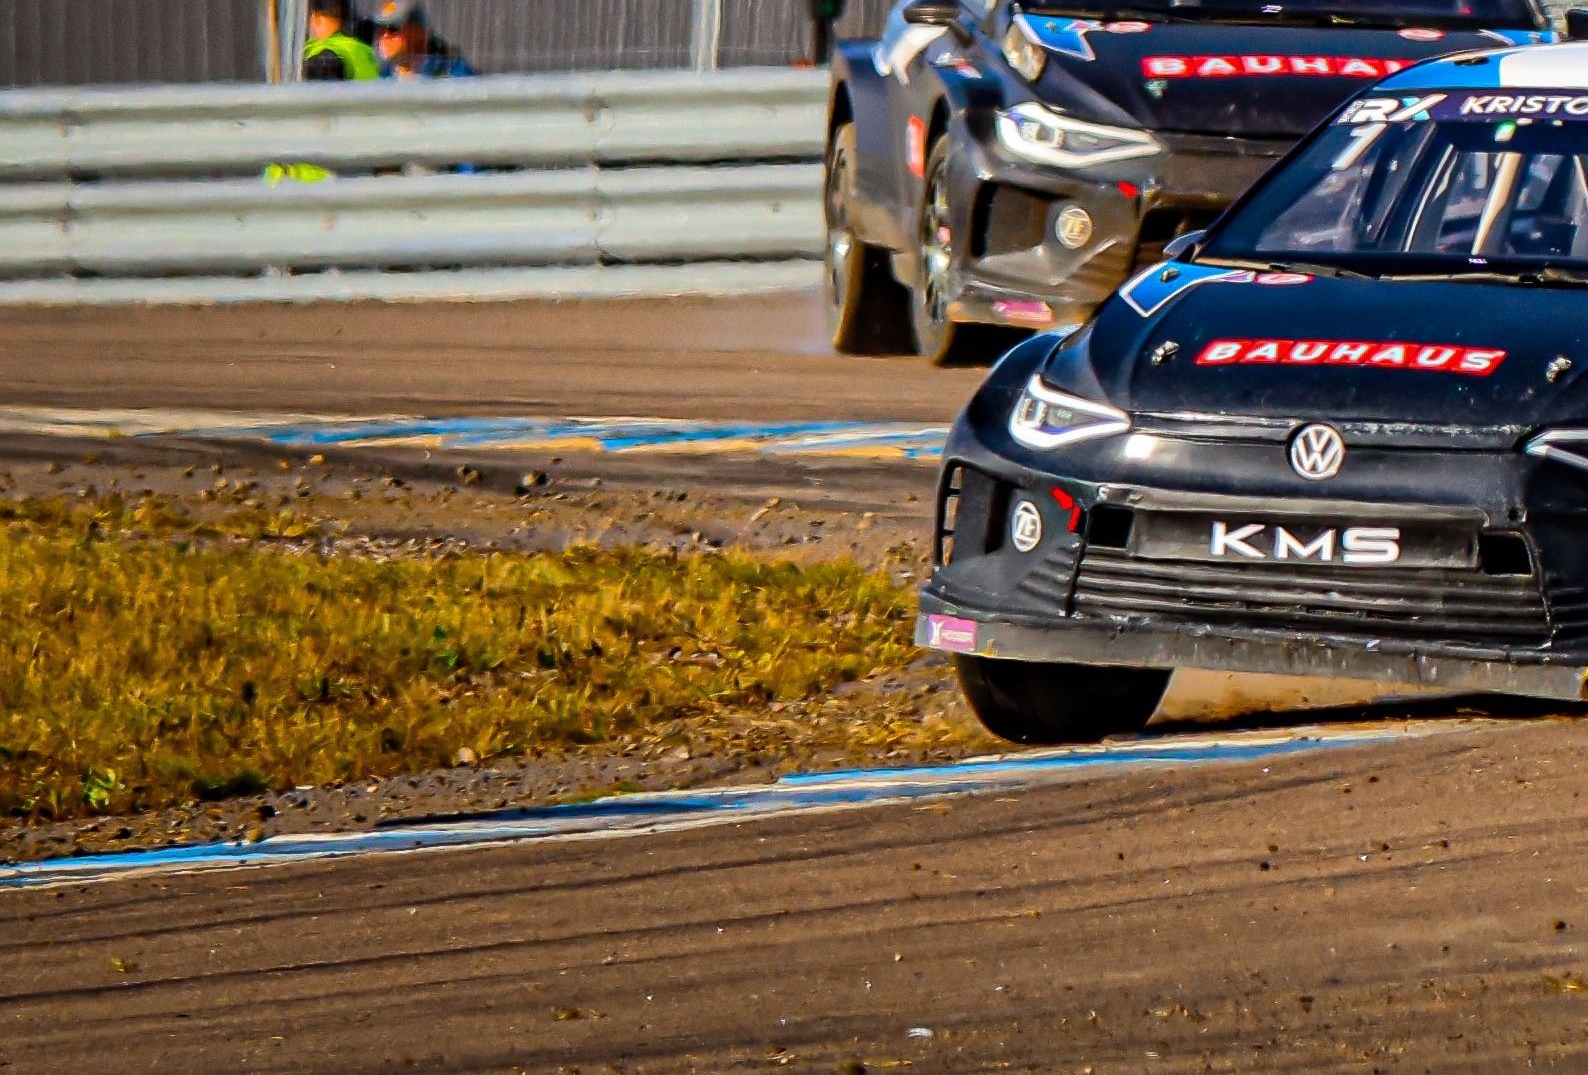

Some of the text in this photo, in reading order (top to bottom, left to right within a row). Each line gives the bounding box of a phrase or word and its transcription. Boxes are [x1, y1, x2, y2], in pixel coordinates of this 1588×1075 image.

[1348, 94, 1448, 124] RX
[1330, 122, 1388, 172] 1
[1204, 341, 1506, 372] BAUHAUS
[1210, 520, 1400, 564] KMS
